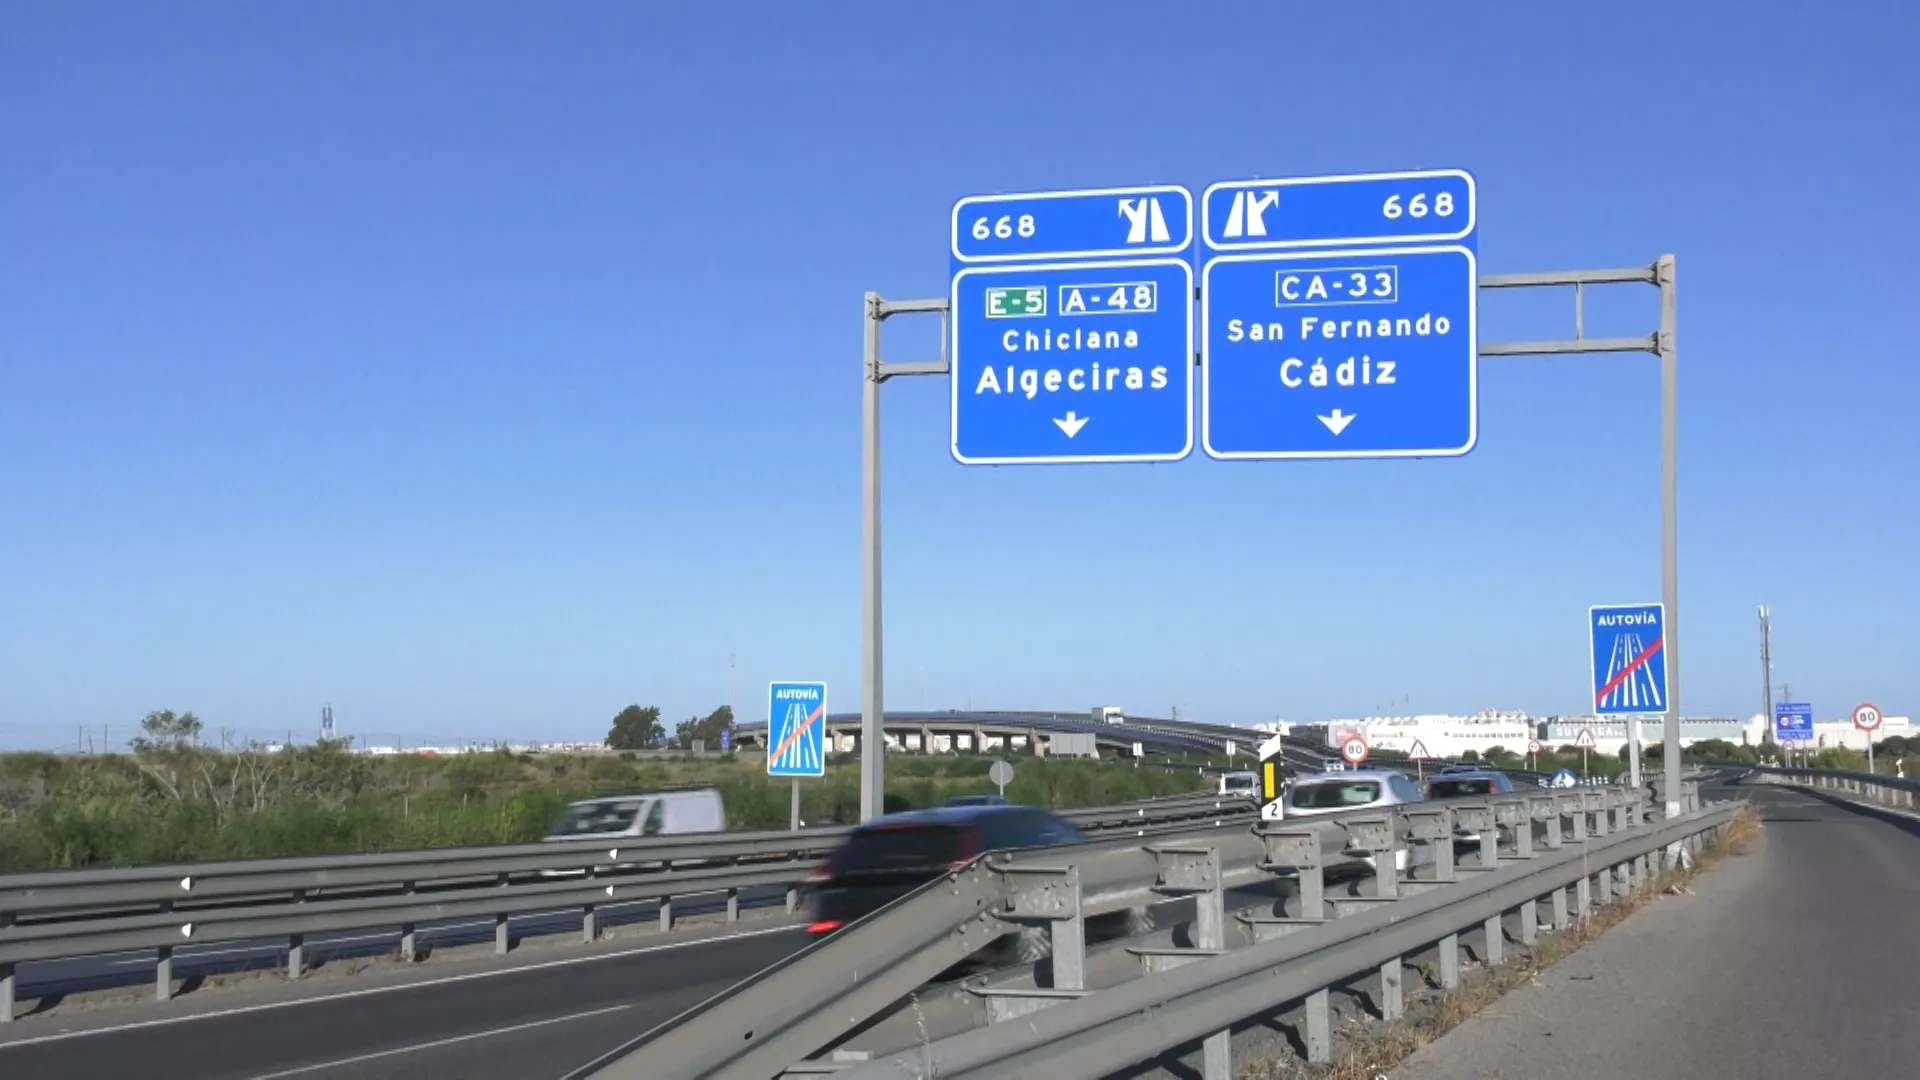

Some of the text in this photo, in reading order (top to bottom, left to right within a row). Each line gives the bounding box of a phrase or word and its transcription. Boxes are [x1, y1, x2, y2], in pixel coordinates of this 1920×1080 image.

[1384, 193, 1454, 219] 668
[972, 215, 1036, 240] 668
[1281, 272, 1393, 301] CA-33
[989, 286, 1153, 314] E-5 A-48
[1227, 312, 1450, 342] San Fernando
[1002, 328, 1138, 352] Chiclana
[975, 362, 1168, 400] Algeciras
[1279, 355, 1396, 388] Cádiz
[1598, 611, 1657, 626] AUTOVÍA
[775, 688, 819, 701] AUTOVÍA
[1859, 711, 1876, 722] 80
[1348, 744, 1363, 754] 80
[1270, 802, 1279, 818] 2
